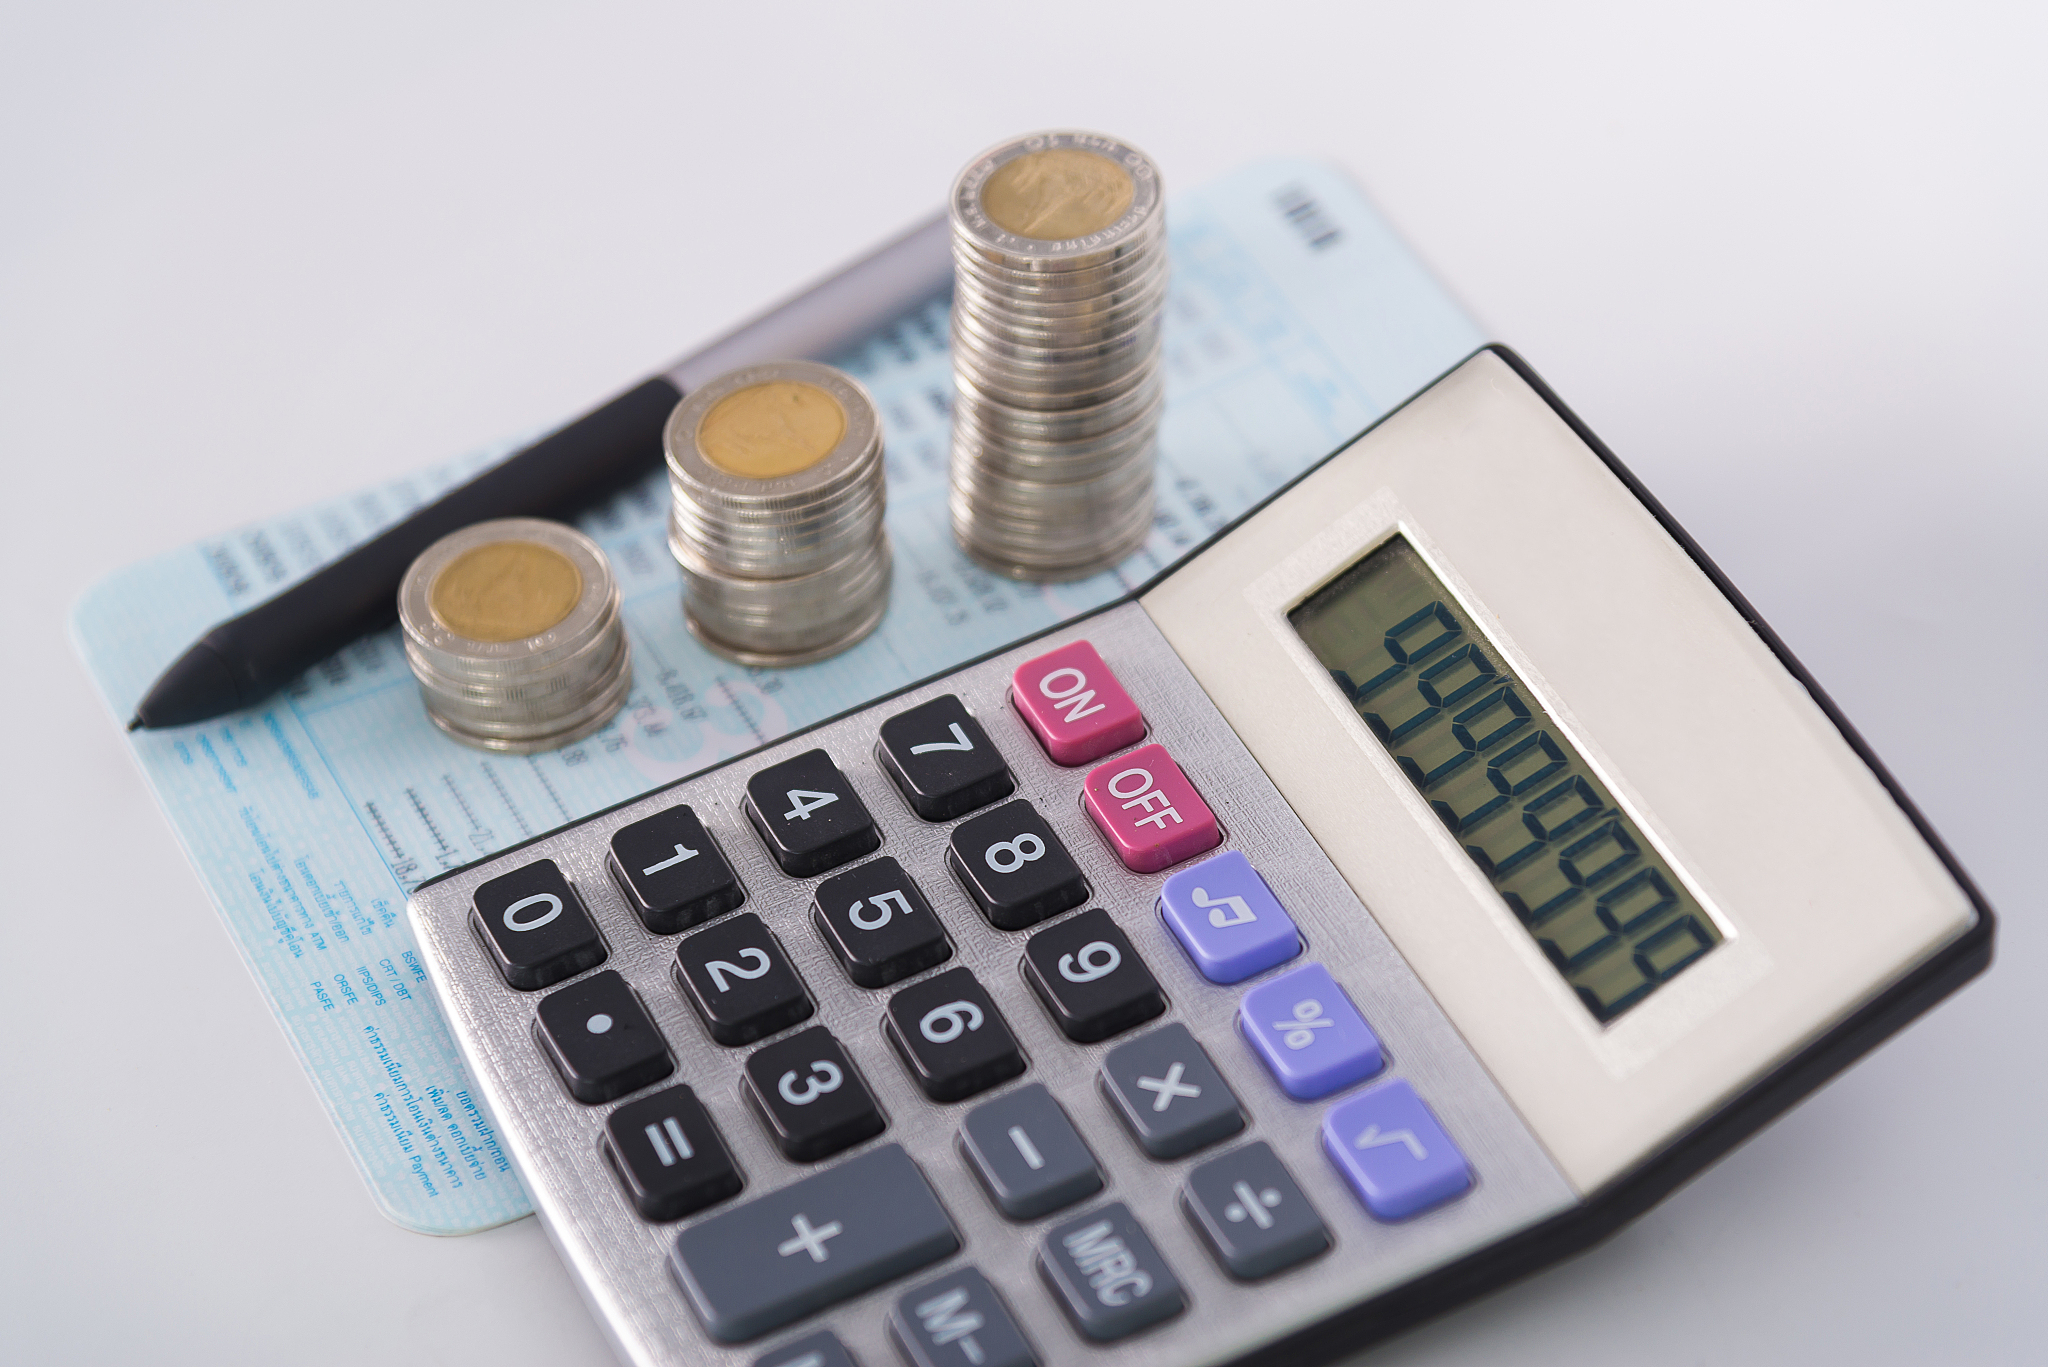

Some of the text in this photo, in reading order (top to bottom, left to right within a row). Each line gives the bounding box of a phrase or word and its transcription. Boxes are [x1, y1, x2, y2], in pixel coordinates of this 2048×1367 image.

[1039, 667, 1105, 723] ON
[910, 722, 973, 755] 7
[783, 789, 839, 821] 4
[1107, 767, 1183, 831] OFF
[643, 843, 699, 876] 1
[985, 832, 1046, 874] 8
[503, 893, 563, 932] 0
[848, 889, 913, 931] 5
[310, 932, 327, 951] ATM
[1058, 940, 1121, 983] 9
[402, 951, 427, 983] BSWFE
[705, 947, 772, 993] 2
[310, 981, 335, 1011] PASFE
[333, 974, 359, 1005] ORSFE
[919, 1000, 984, 1043] 6
[1271, 998, 1335, 1050] %
[778, 1059, 844, 1106] 3
[409, 1155, 439, 1198] Payment
[777, 1213, 843, 1263] +
[1061, 1219, 1154, 1307] MRC
[914, 1285, 986, 1366] M-
